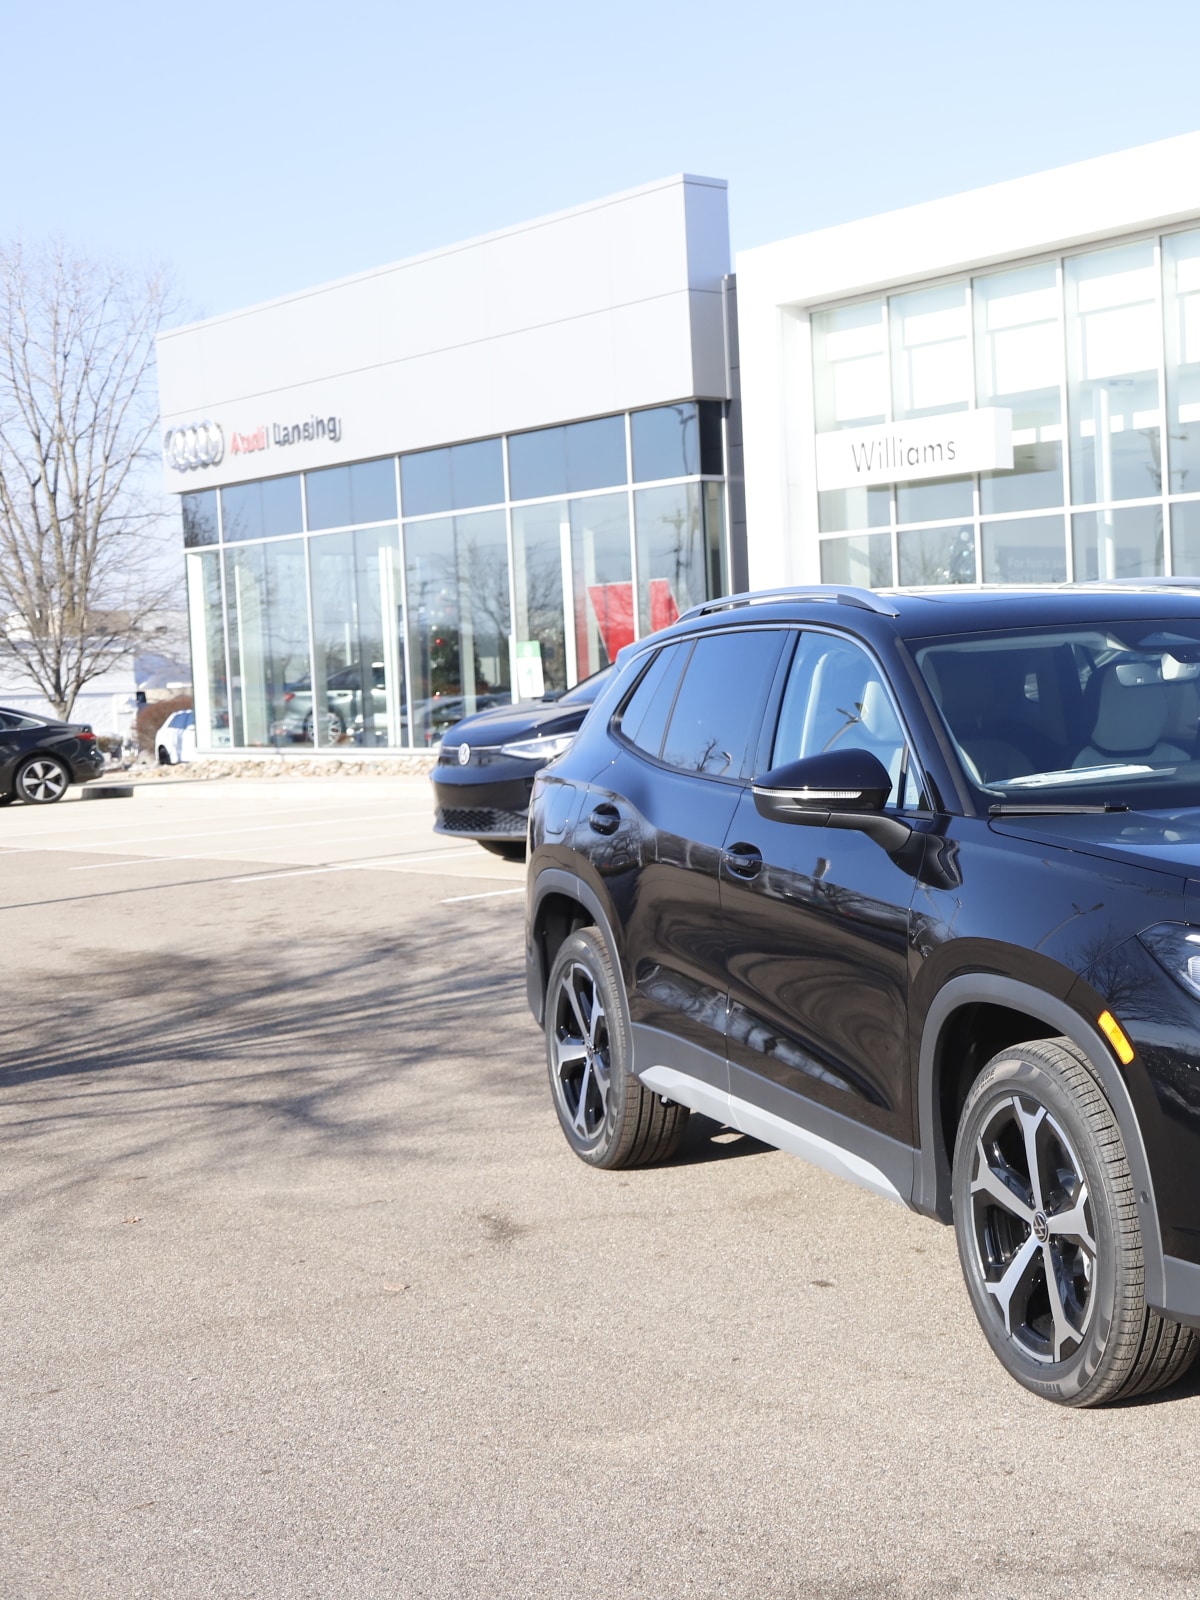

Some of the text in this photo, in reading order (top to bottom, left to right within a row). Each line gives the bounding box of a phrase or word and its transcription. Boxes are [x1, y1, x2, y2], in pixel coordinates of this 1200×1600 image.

[230, 415, 341, 454] Audi Lansing
[851, 436, 956, 472] Williams
